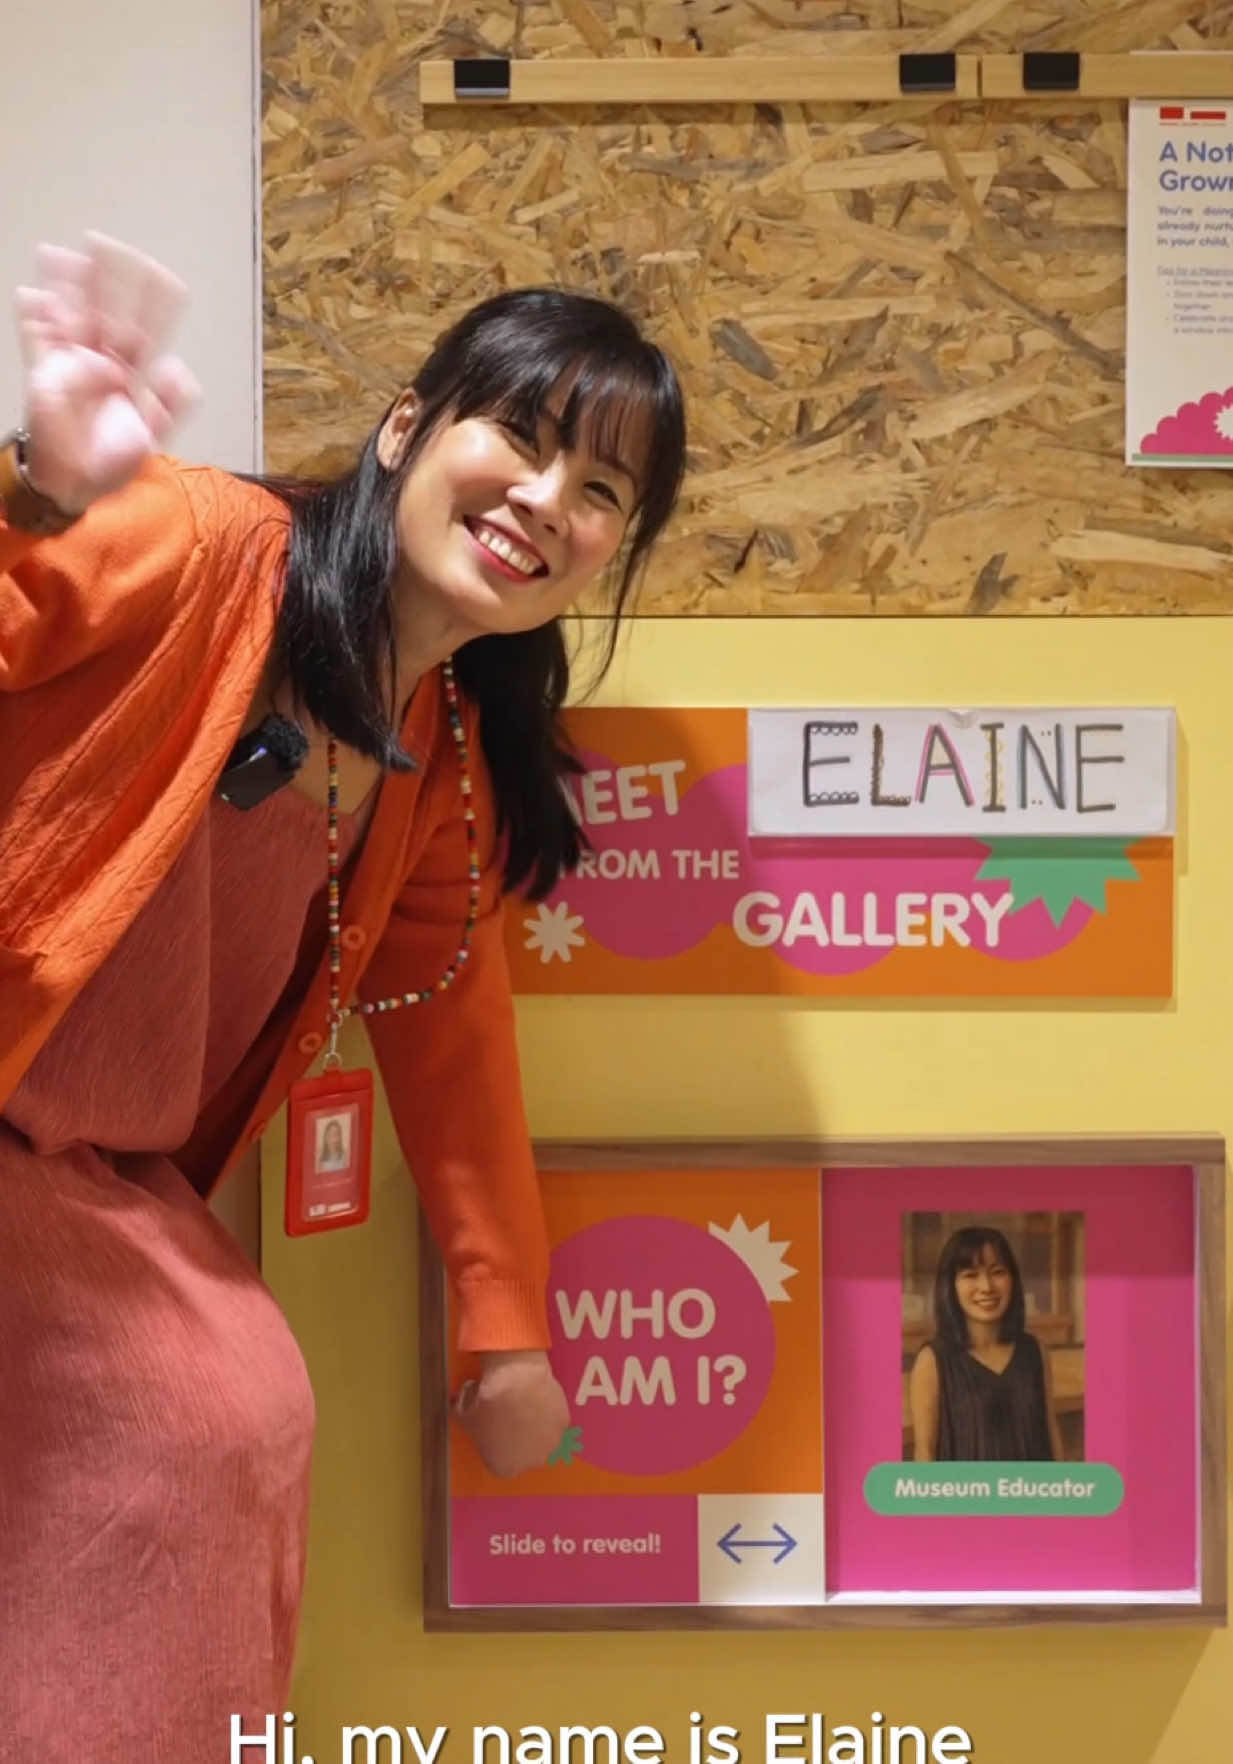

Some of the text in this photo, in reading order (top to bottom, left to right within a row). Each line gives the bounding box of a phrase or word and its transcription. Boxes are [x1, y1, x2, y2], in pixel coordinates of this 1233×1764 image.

[1159, 141, 1233, 163] A Not
[558, 759, 686, 825] EET
[803, 721, 1125, 813] ELAINE
[559, 849, 740, 880] ROM THE
[733, 891, 1014, 947] GALLERY
[555, 1288, 716, 1340] WHO
[575, 1354, 747, 1406] AM I?
[895, 1477, 1095, 1498] Museum Educator
[489, 1532, 661, 1555] Slide to reveal!
